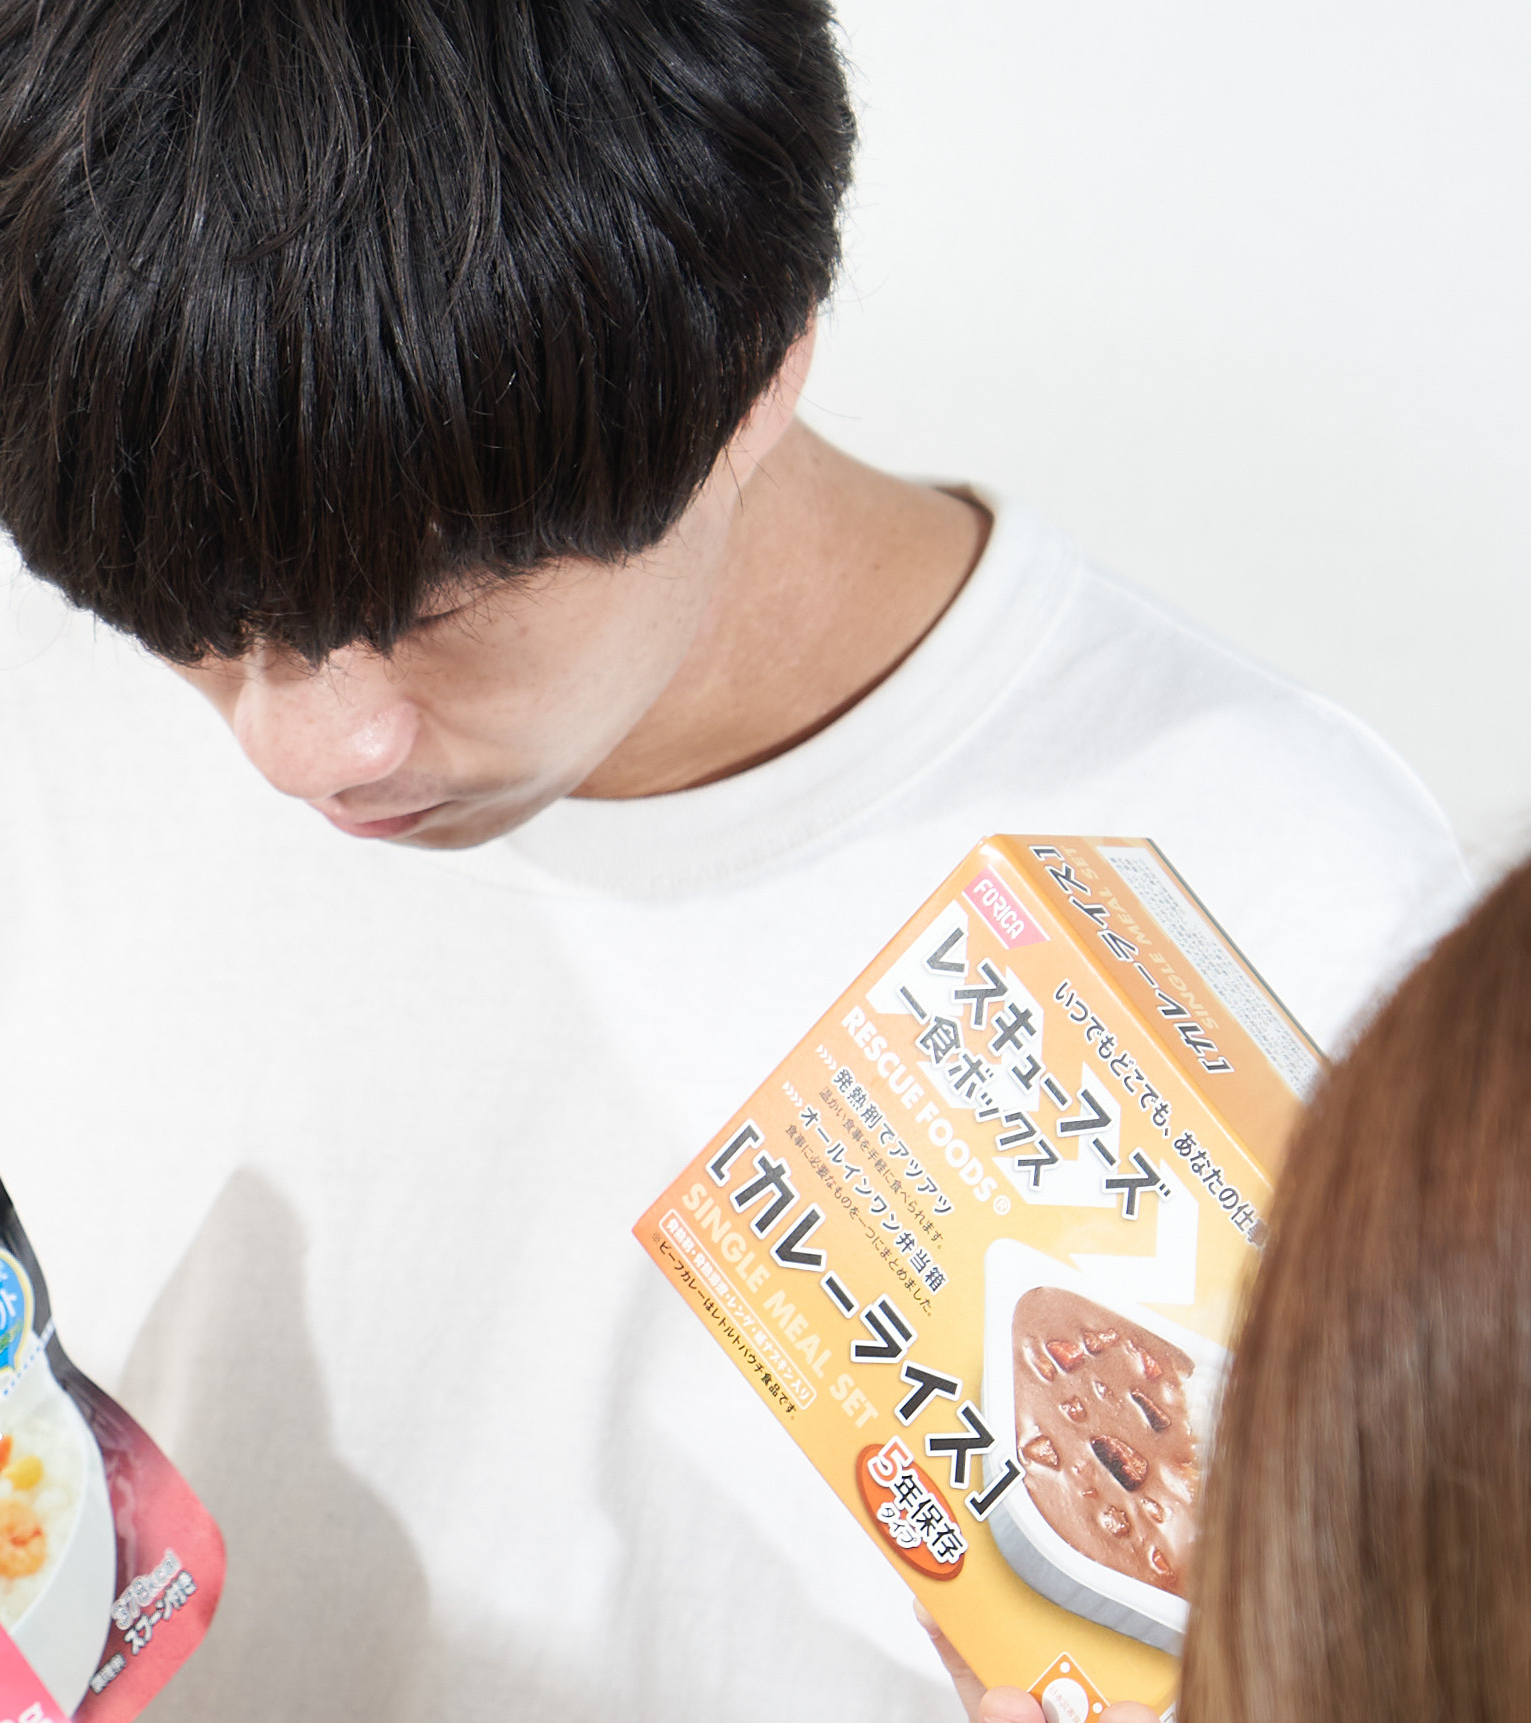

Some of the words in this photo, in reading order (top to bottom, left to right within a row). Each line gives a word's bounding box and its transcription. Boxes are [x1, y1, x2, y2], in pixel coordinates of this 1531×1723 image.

[973, 878, 1027, 940] FORICA
[832, 1067, 954, 1216] 発熱剤でアツアツ
[841, 1006, 927, 1110] RESCUE
[916, 1106, 998, 1204] FOODS
[894, 982, 1062, 1191] 一食ボックス
[924, 926, 1174, 1221] レスキューフーズ
[799, 1104, 948, 1293] オールインワン弁当箱
[682, 1181, 771, 1297] SINGLE
[762, 1288, 834, 1380] MEAL
[828, 1372, 880, 1430] SET
[868, 1436, 968, 1562] 5年保存
[877, 1502, 922, 1549] タイプ
